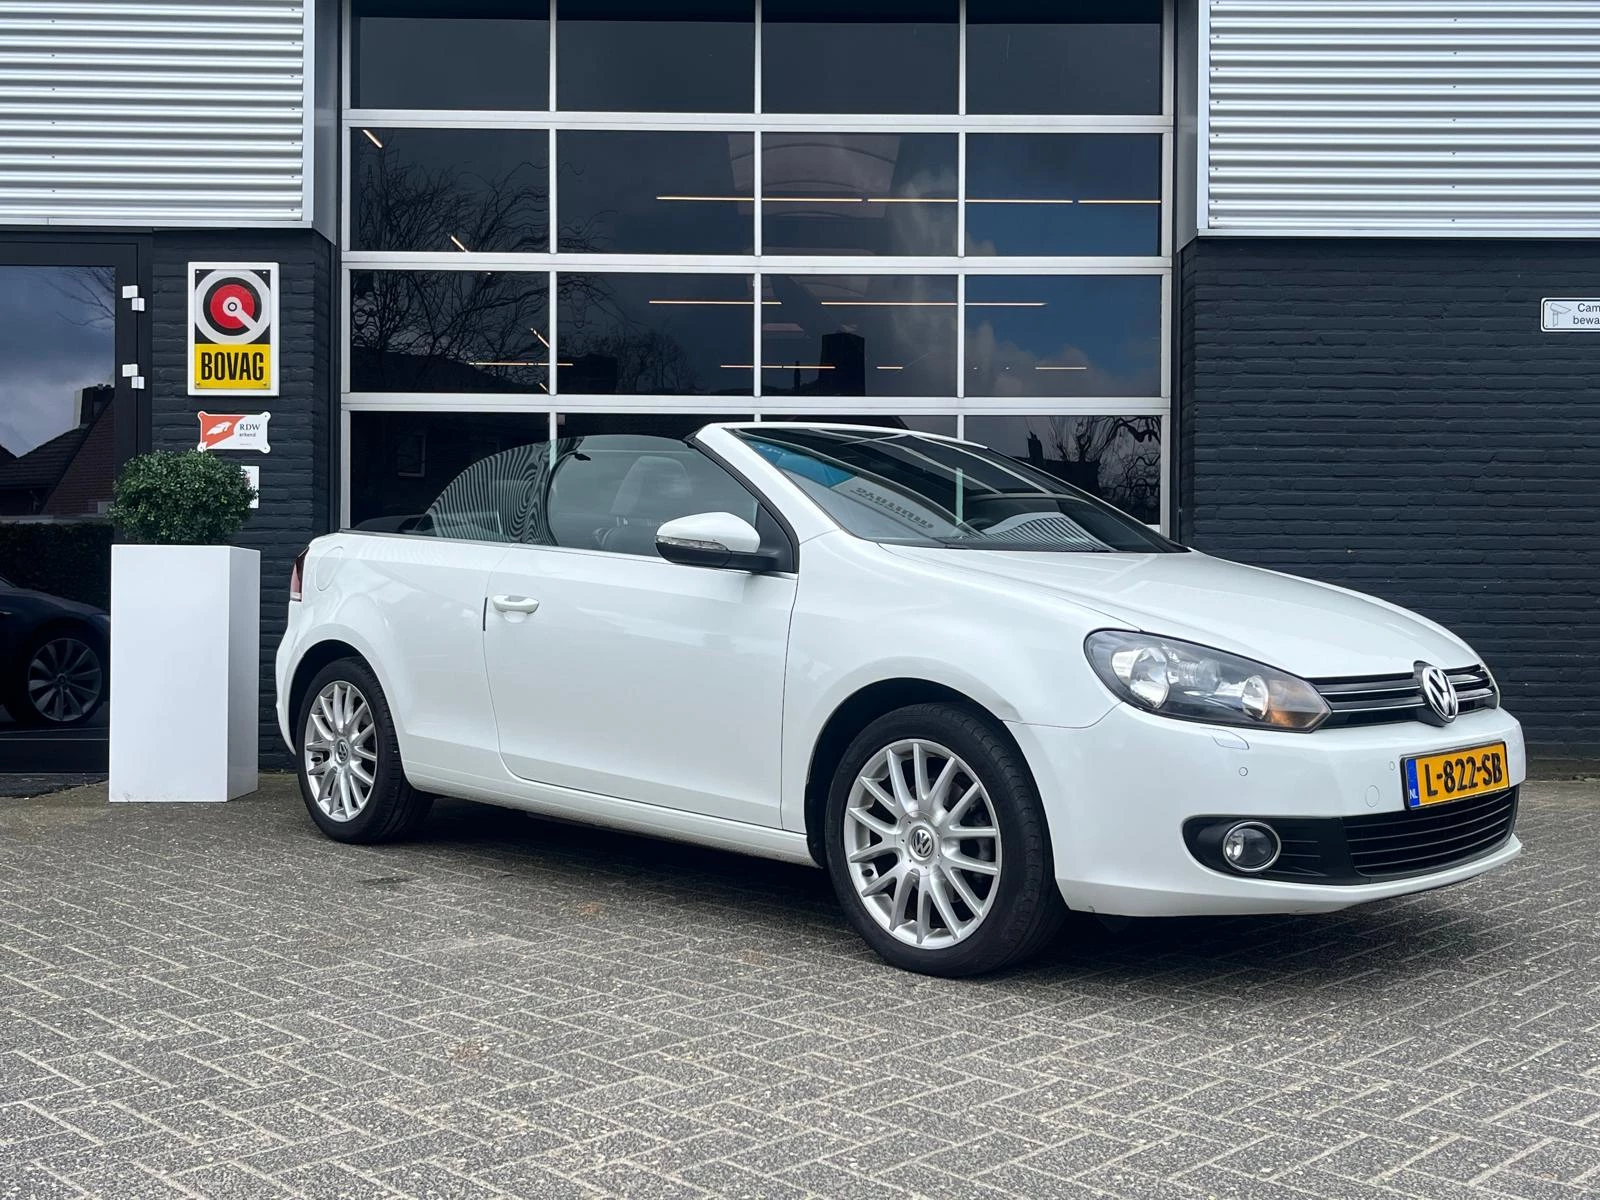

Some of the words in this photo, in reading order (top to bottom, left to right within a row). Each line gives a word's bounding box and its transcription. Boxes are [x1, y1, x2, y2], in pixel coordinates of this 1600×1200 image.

[1577, 302, 1600, 313] Cam
[201, 352, 264, 381] BOVAG
[239, 423, 261, 431] RDW
[1424, 752, 1503, 797] L-822-SB
[1409, 789, 1418, 800] NL
